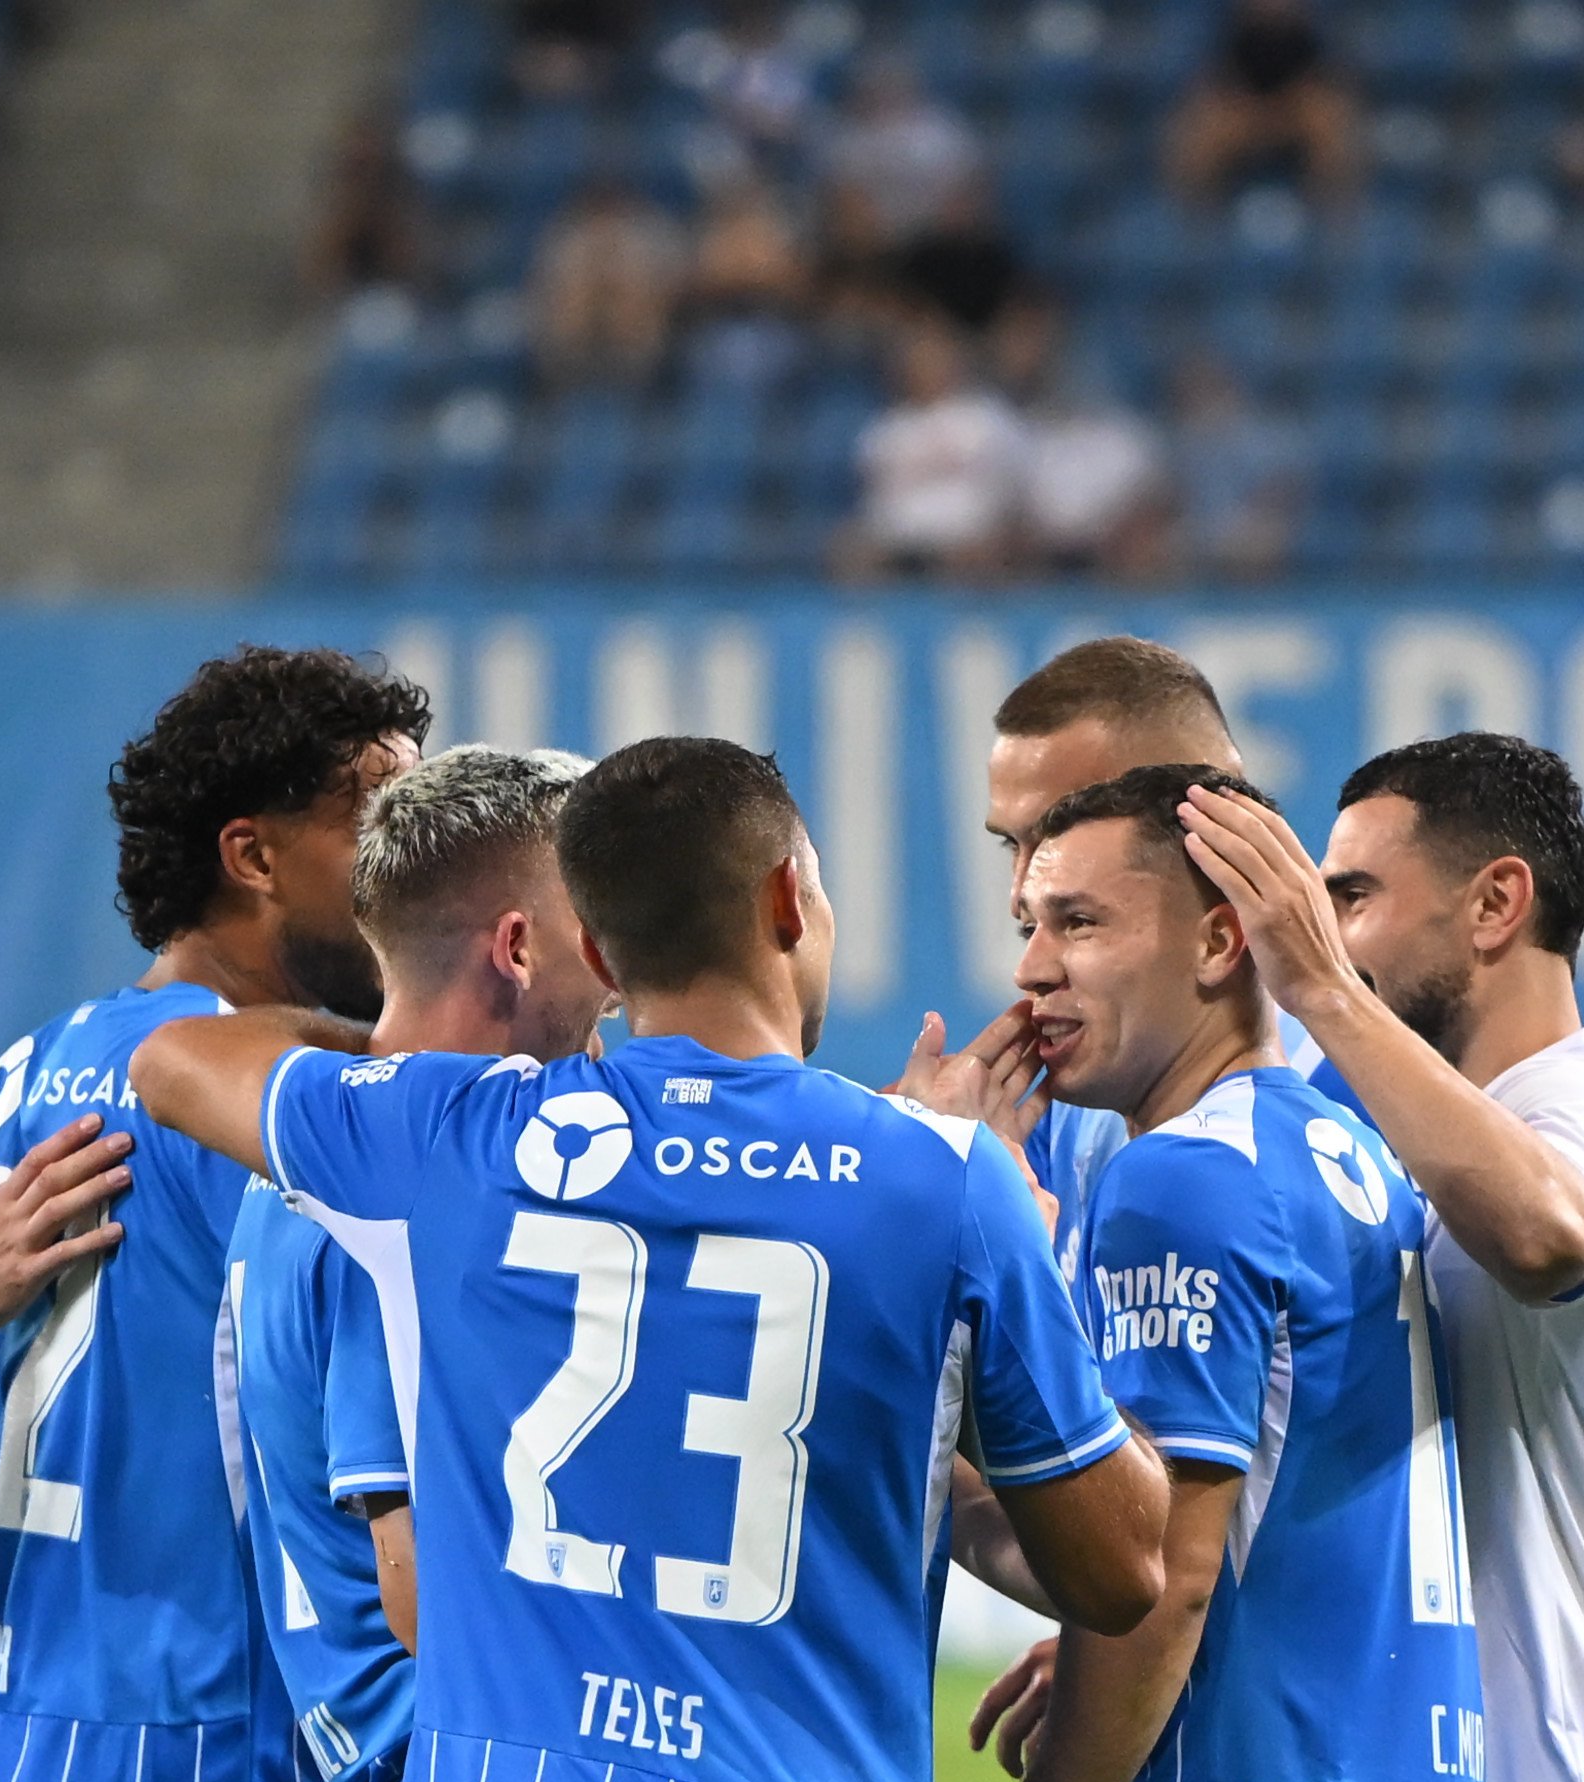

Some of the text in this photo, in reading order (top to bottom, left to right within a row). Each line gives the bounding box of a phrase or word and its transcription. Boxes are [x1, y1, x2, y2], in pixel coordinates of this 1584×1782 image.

[654, 1137, 862, 1183] OSCAR
[1094, 1252, 1219, 1317] Drinks
[502, 1210, 830, 1627] 23
[1396, 1250, 1477, 1627] 1
[578, 1670, 704, 1760] TELES
